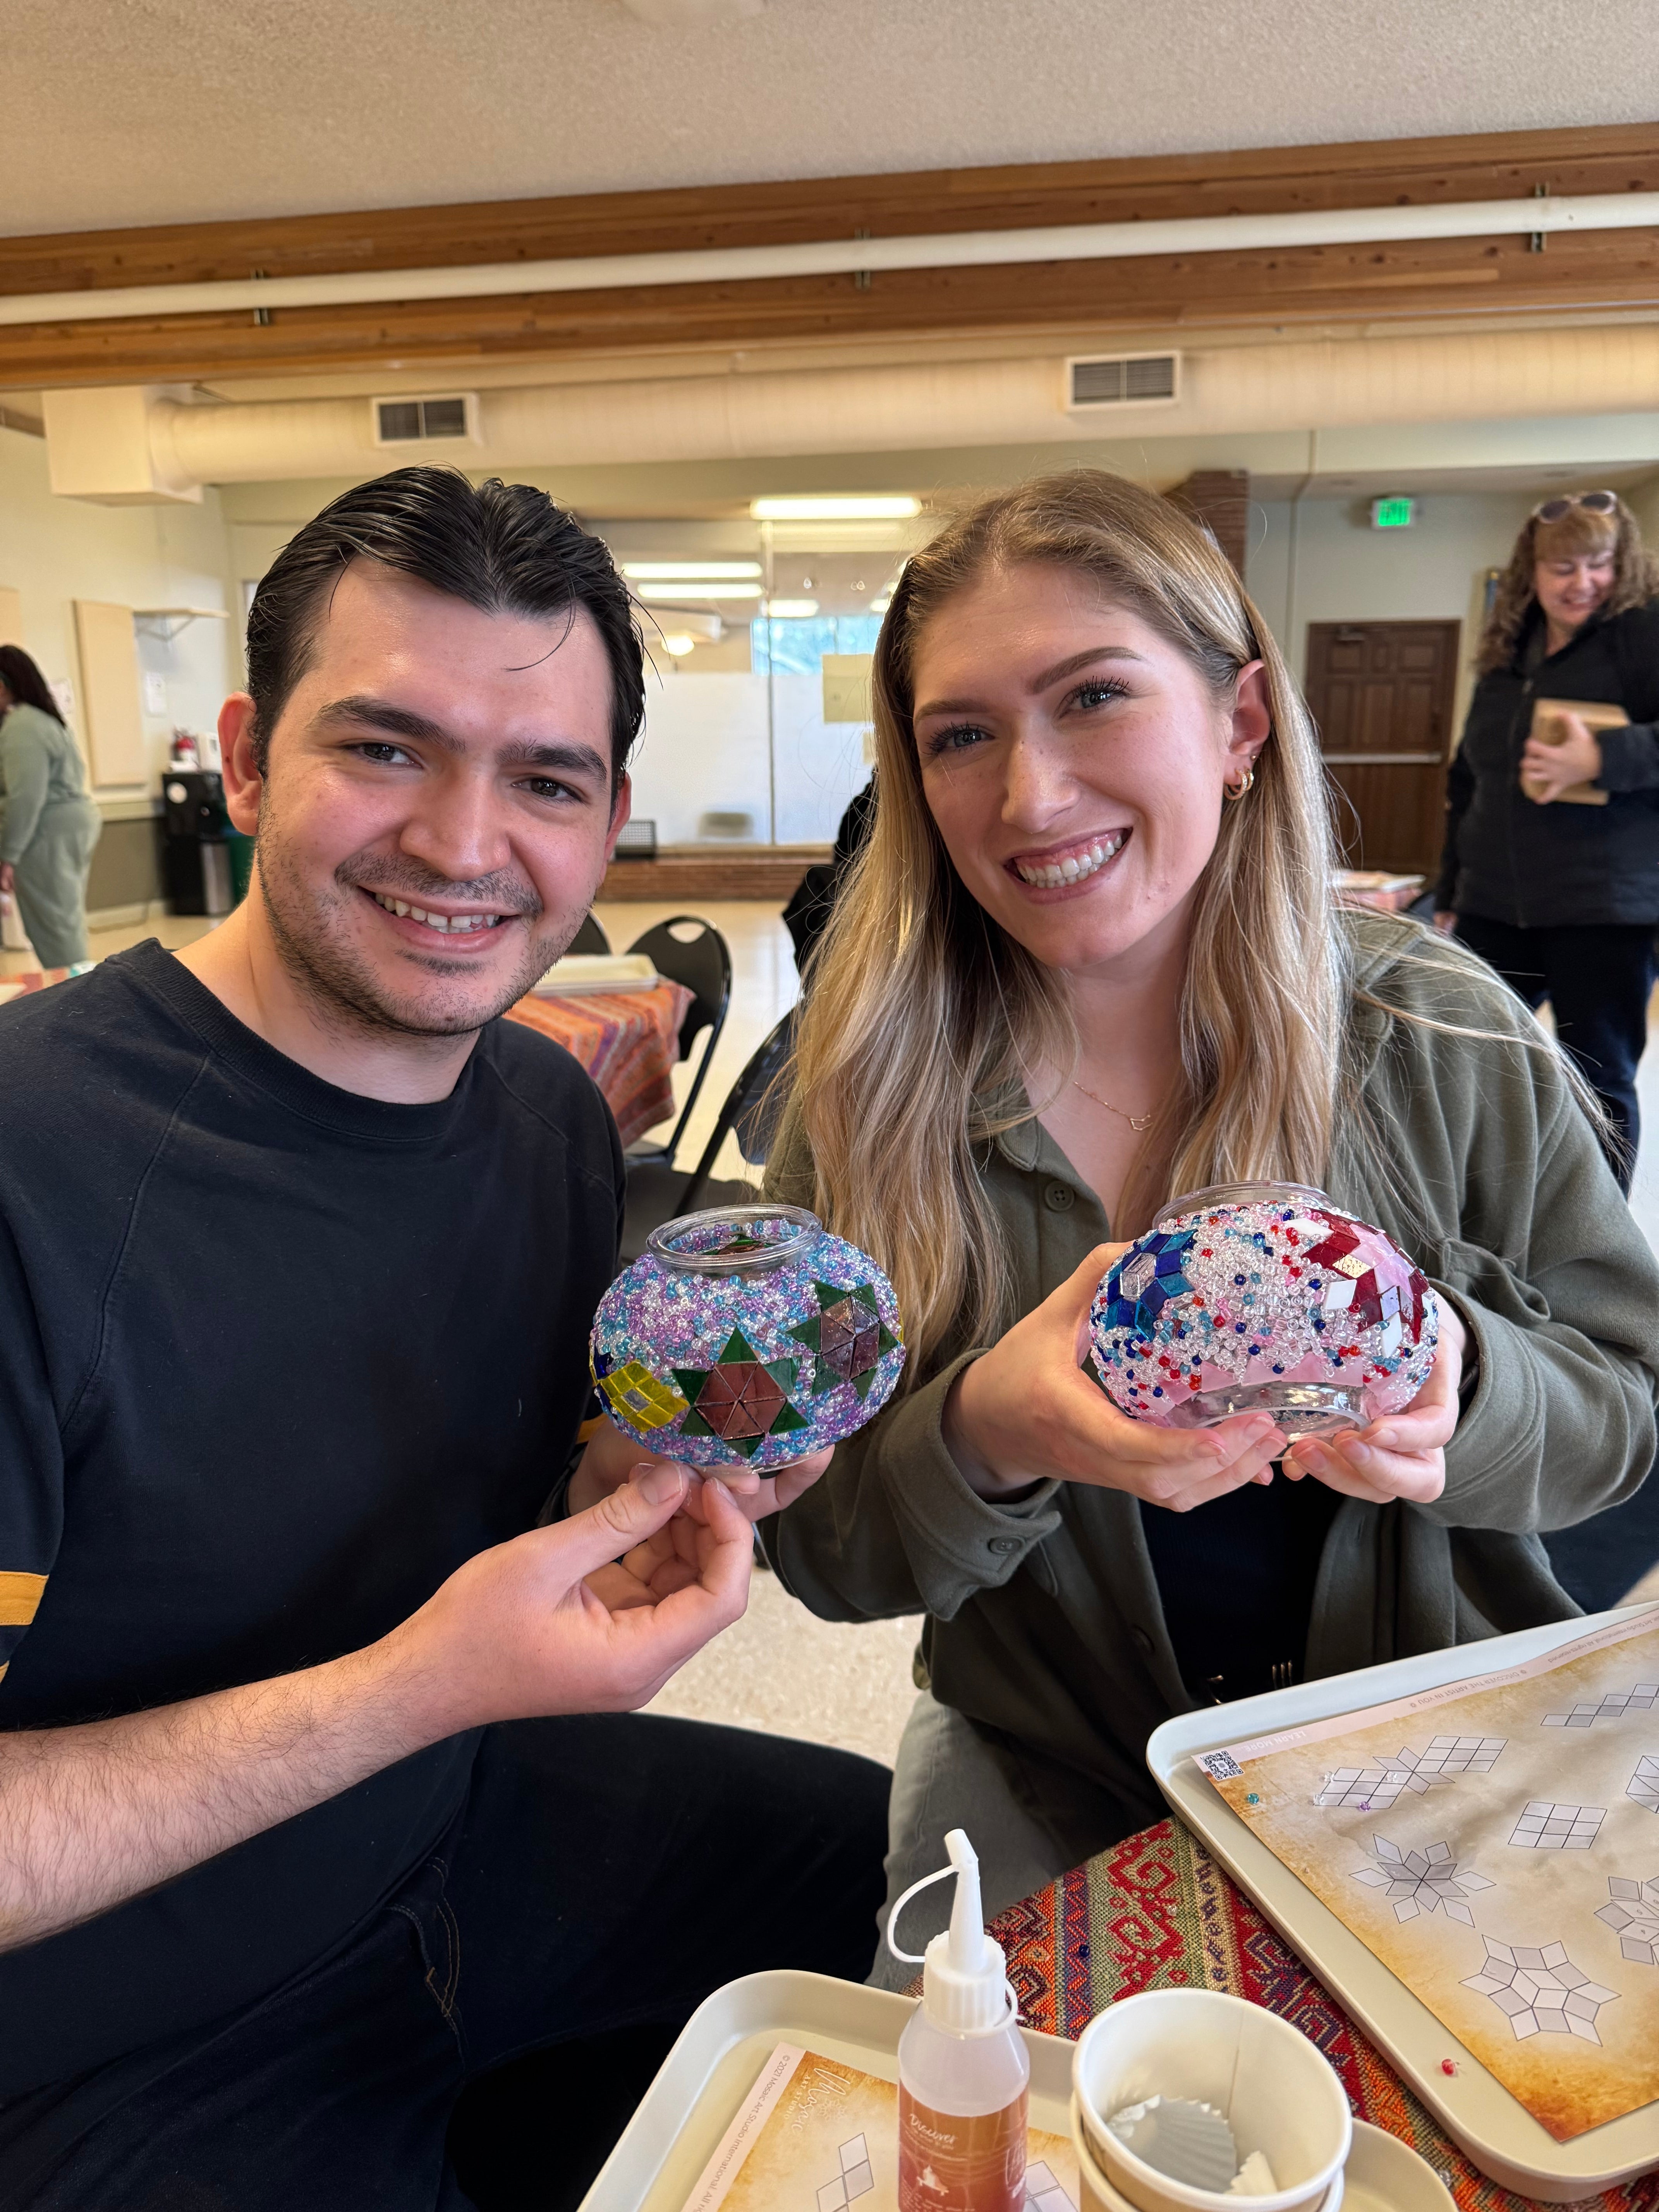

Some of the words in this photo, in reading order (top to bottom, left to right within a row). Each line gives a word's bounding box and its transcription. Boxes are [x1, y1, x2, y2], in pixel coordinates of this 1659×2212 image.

[1468, 1680, 1484, 1688] THE
[1485, 1672, 1519, 1684] DISCOVER
[1445, 1685, 1468, 1697] ARTIST
[1274, 1730, 1307, 1744] LEARN
[774, 2061, 787, 2077] 2021
[759, 2077, 778, 2101] Mosaic
[800, 2075, 811, 2089] ART
[752, 2101, 763, 2113] Art
[783, 2091, 802, 2120] STUDIO
[791, 2068, 850, 2134] Mosaic
[738, 2113, 757, 2138] Studio
[701, 2191, 713, 2203] All
